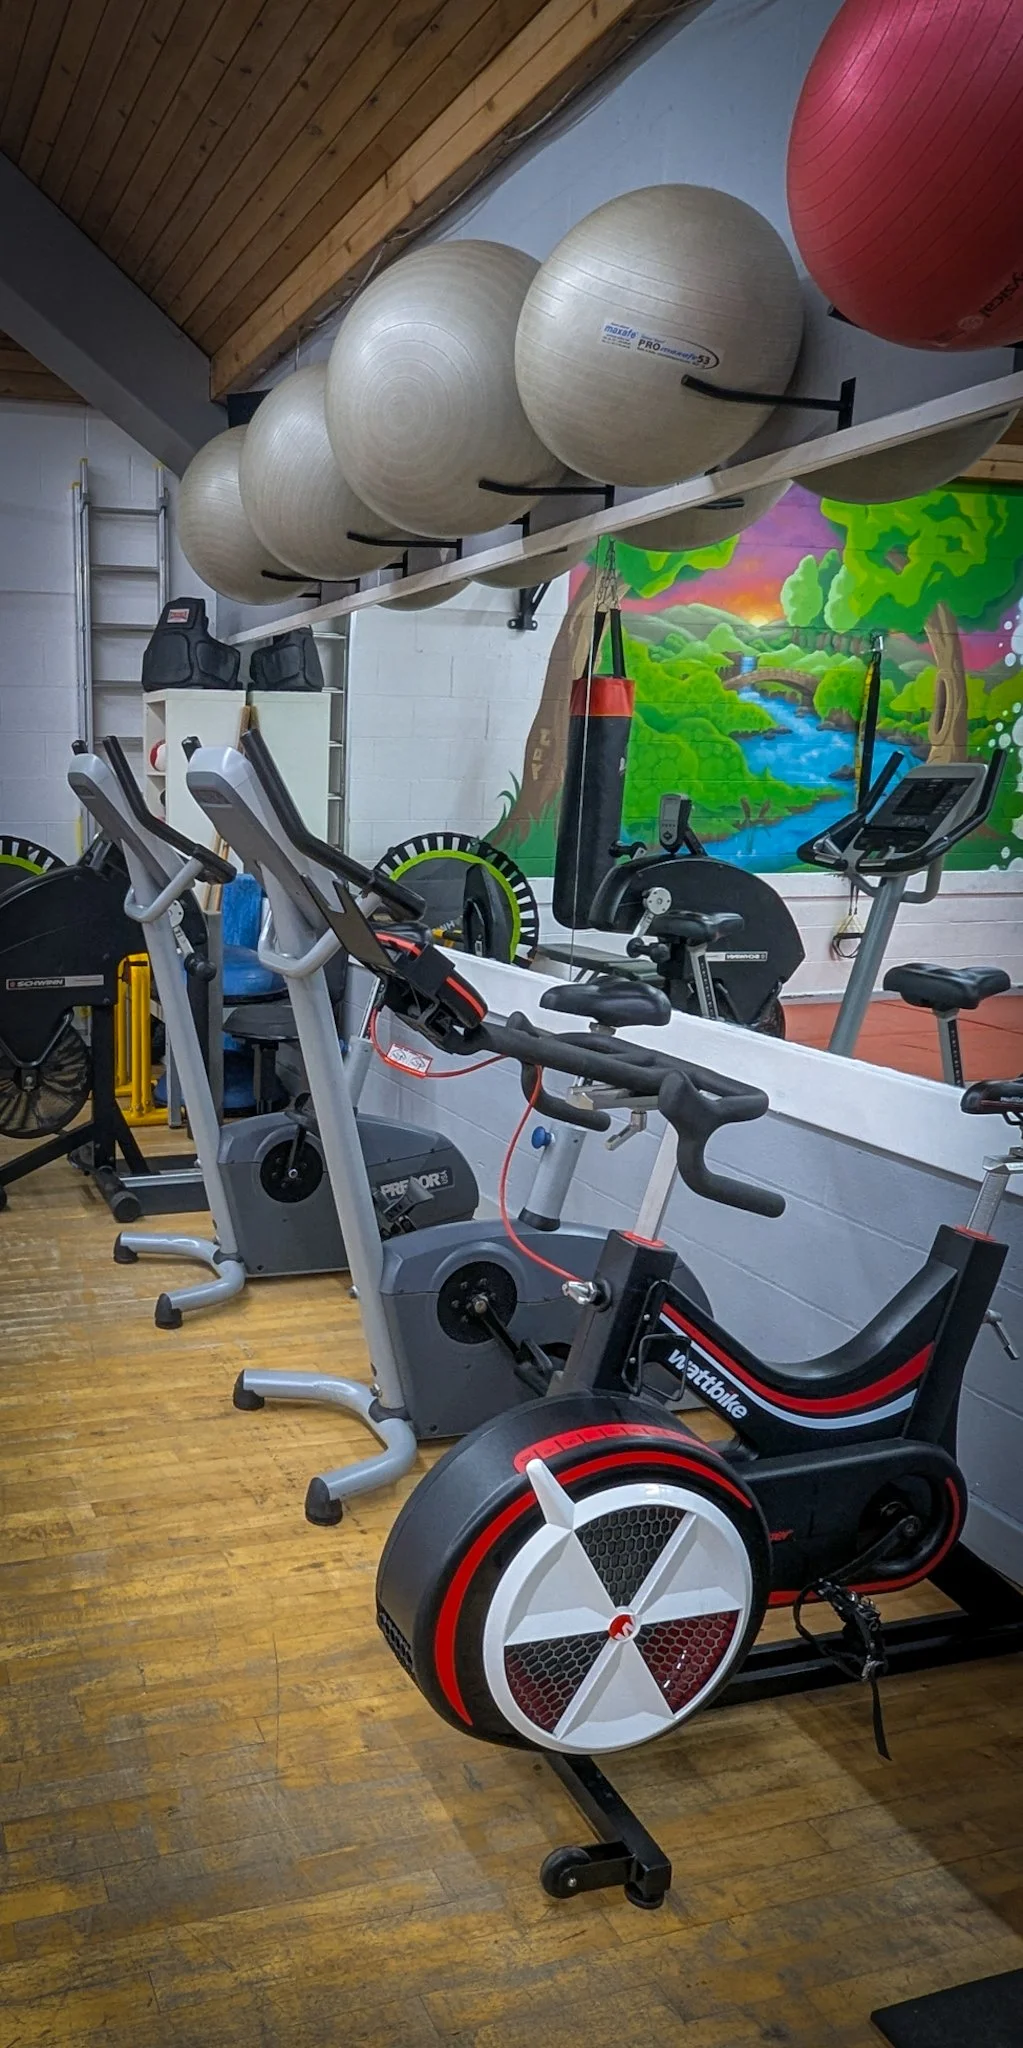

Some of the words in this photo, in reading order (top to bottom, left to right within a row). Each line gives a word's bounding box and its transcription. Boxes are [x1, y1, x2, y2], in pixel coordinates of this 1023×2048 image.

[977, 271, 1023, 318] ysical
[17, 979, 63, 988] SCHWINN
[380, 1172, 441, 1197] PREOR
[667, 1348, 748, 1419] wattbike
